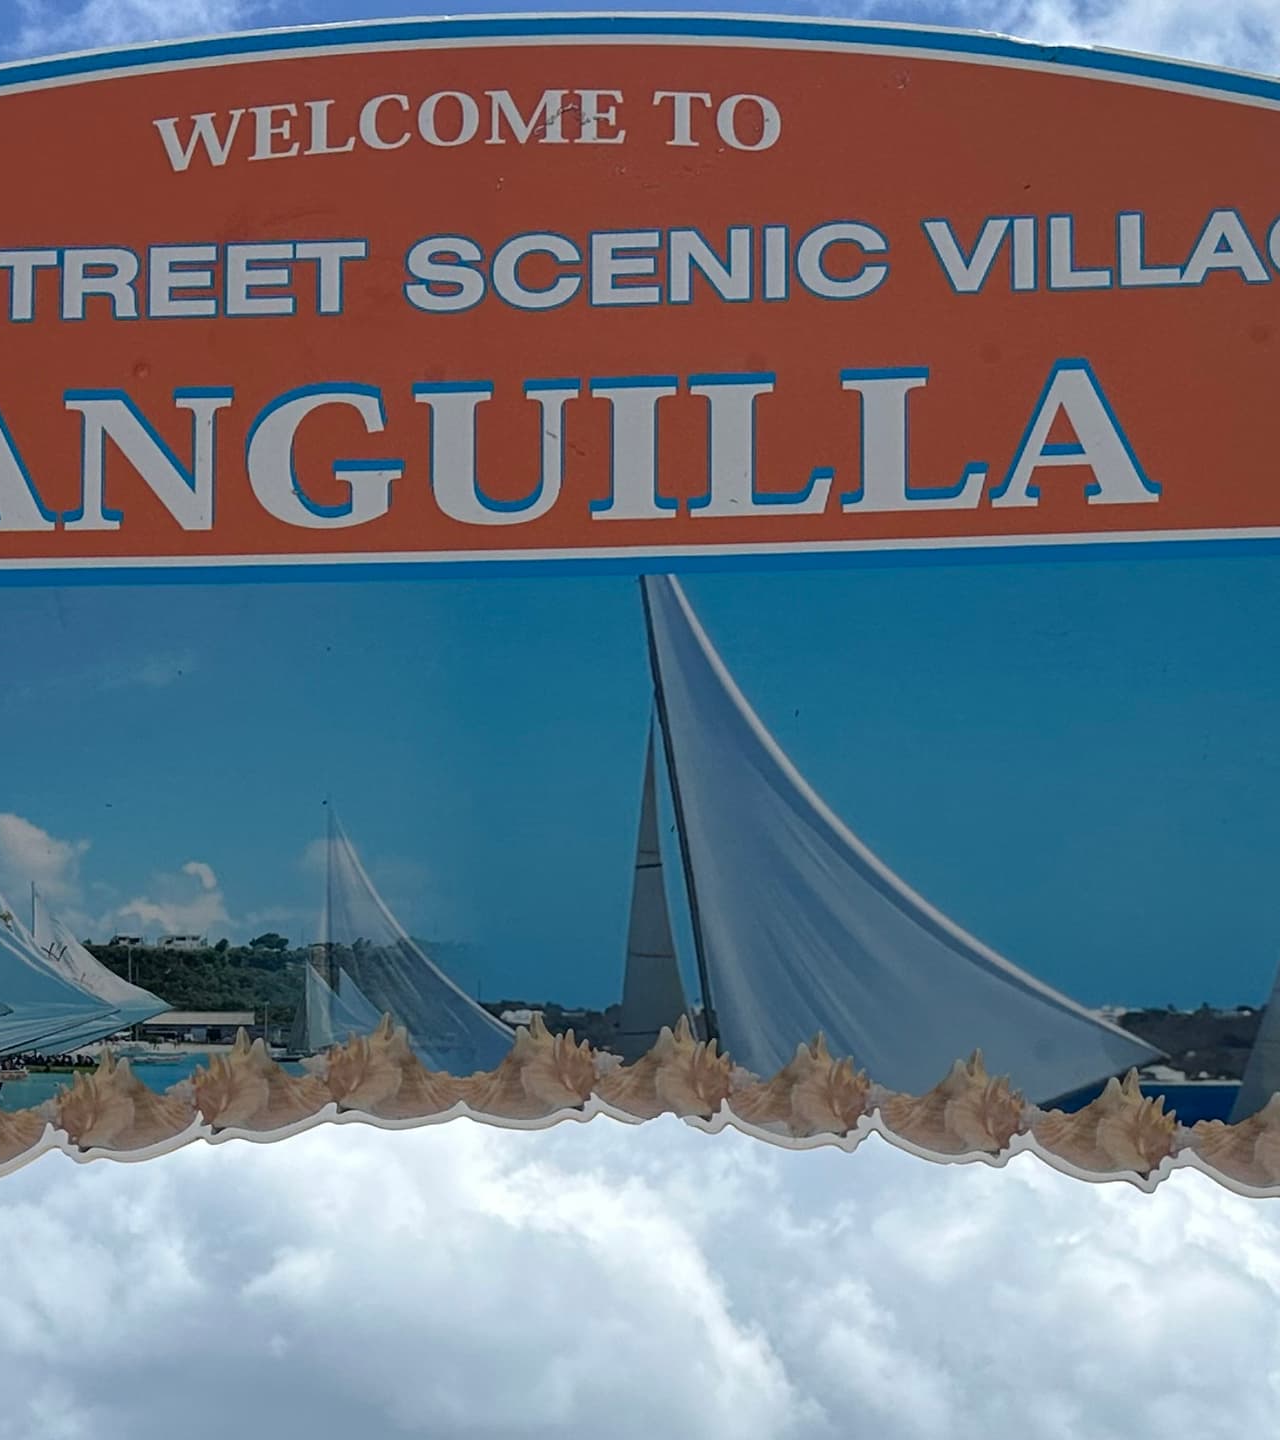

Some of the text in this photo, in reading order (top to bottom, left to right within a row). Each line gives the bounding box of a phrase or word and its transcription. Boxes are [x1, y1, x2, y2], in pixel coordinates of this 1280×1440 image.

[153, 89, 782, 172] WELCOME TO
[404, 219, 889, 313] SCENIC
